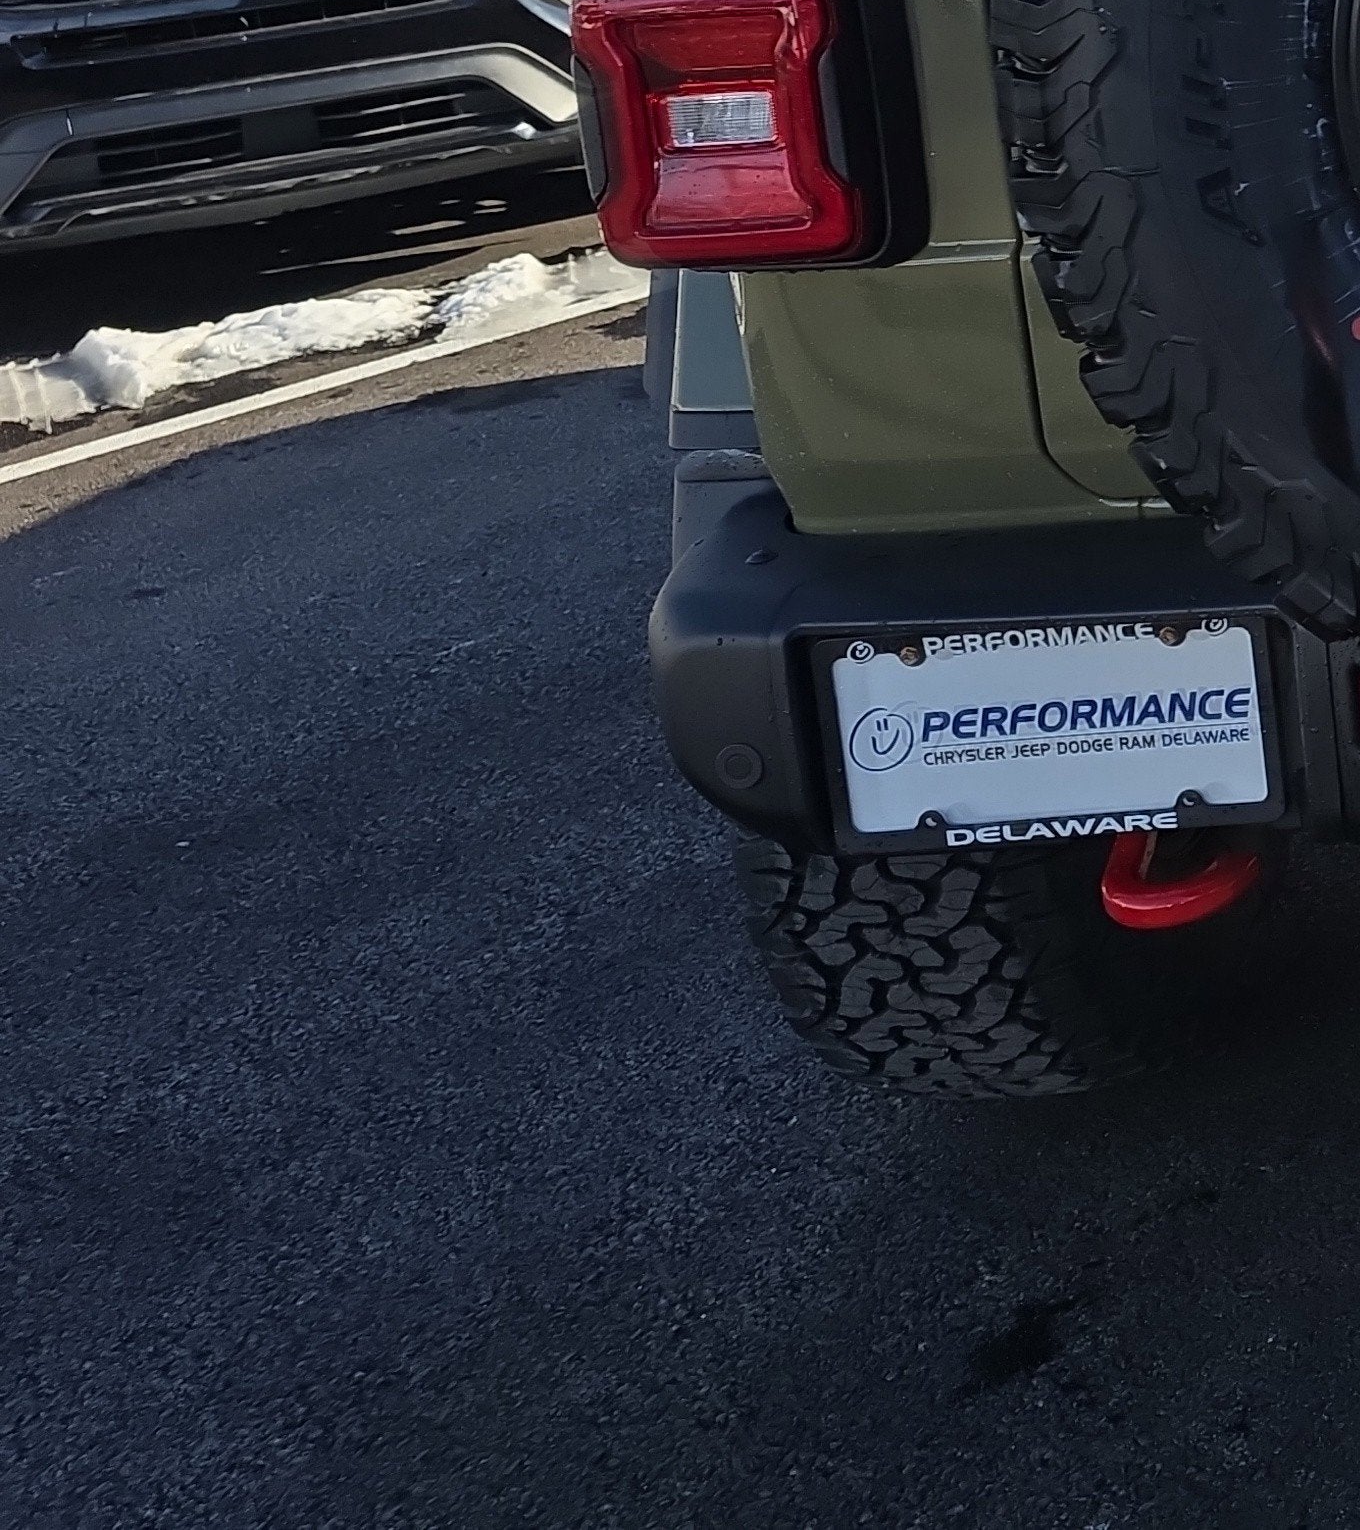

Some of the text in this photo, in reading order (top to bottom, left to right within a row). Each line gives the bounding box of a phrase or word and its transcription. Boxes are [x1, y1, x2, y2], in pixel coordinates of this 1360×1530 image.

[922, 622, 1155, 657] PERFORMANCE
[921, 687, 1252, 742] PERFORMANCE
[923, 728, 1251, 766] CHRYSLER JEEP DODGE RAM DELAWARE
[946, 811, 1179, 848] DELAWARE
